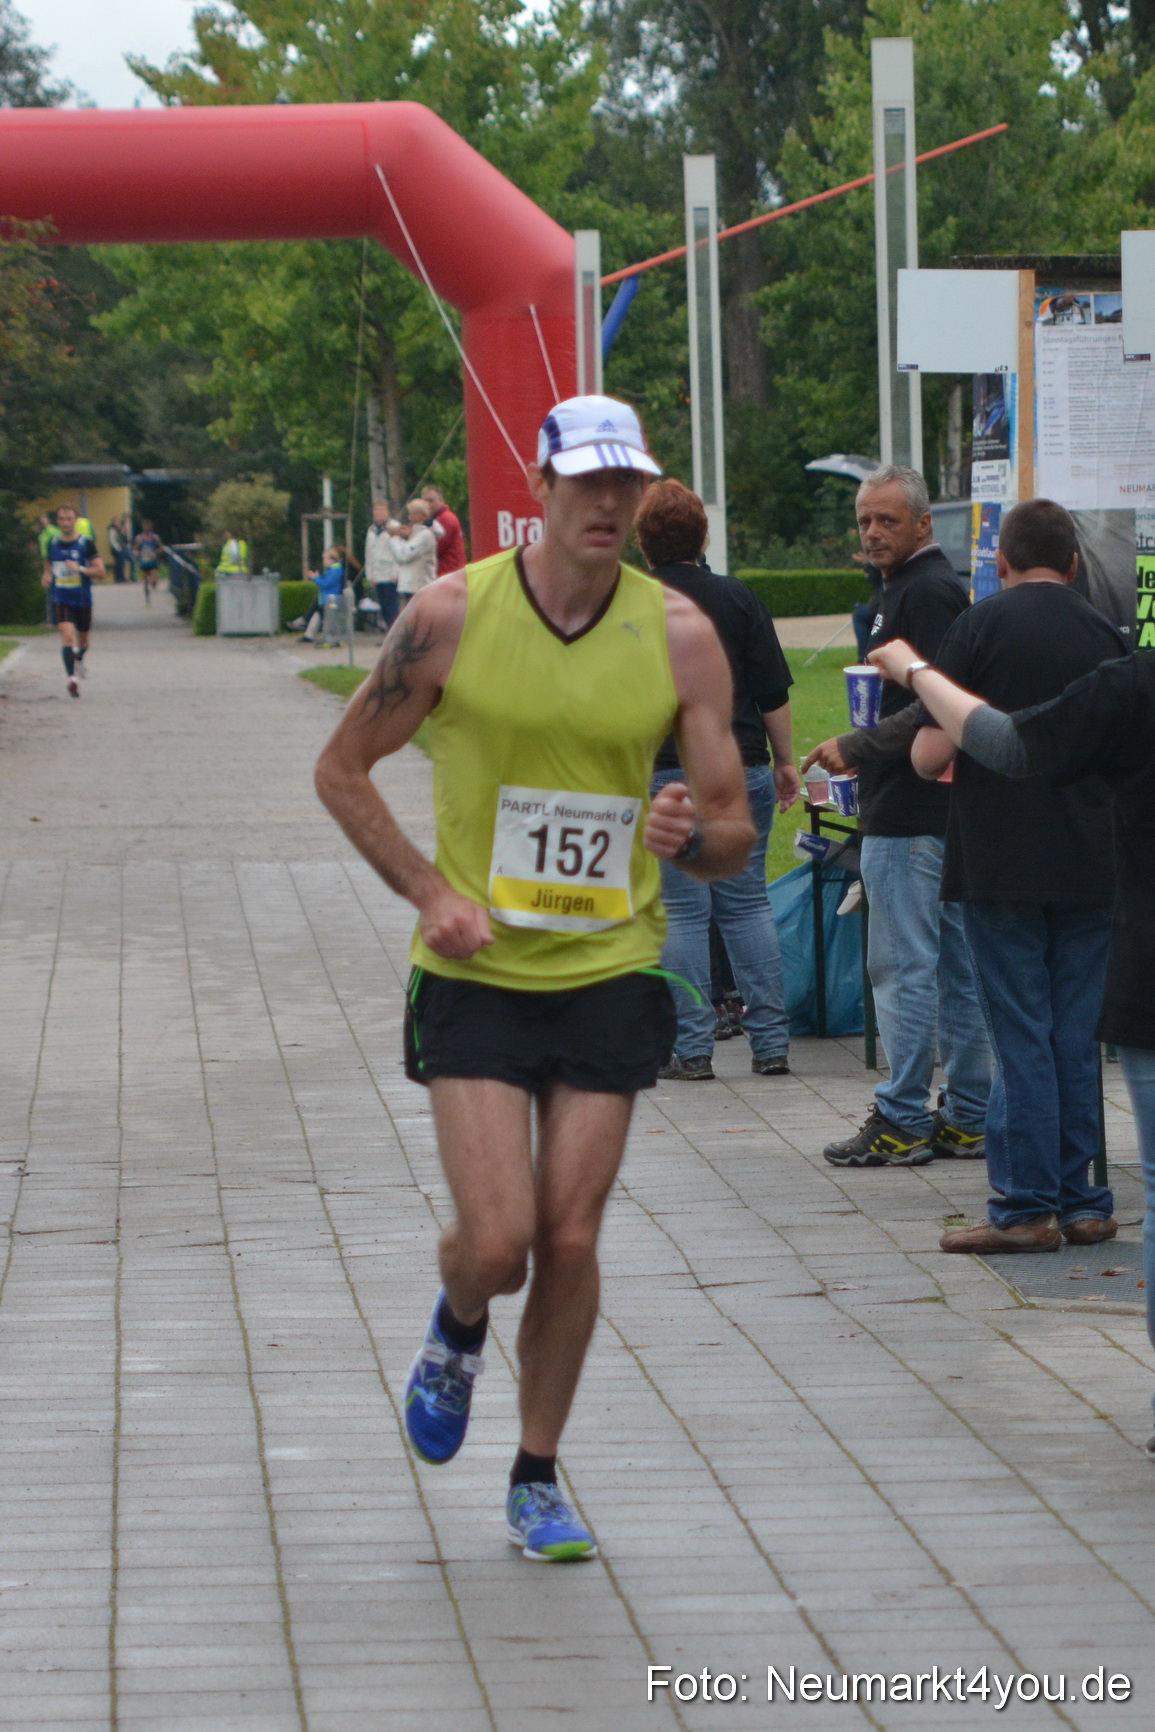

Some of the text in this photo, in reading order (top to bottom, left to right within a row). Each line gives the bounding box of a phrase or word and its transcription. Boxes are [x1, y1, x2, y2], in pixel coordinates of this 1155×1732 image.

[501, 798, 617, 822] PARTL Neumarkt
[527, 824, 611, 879] 152
[531, 888, 594, 914] Jürgen
